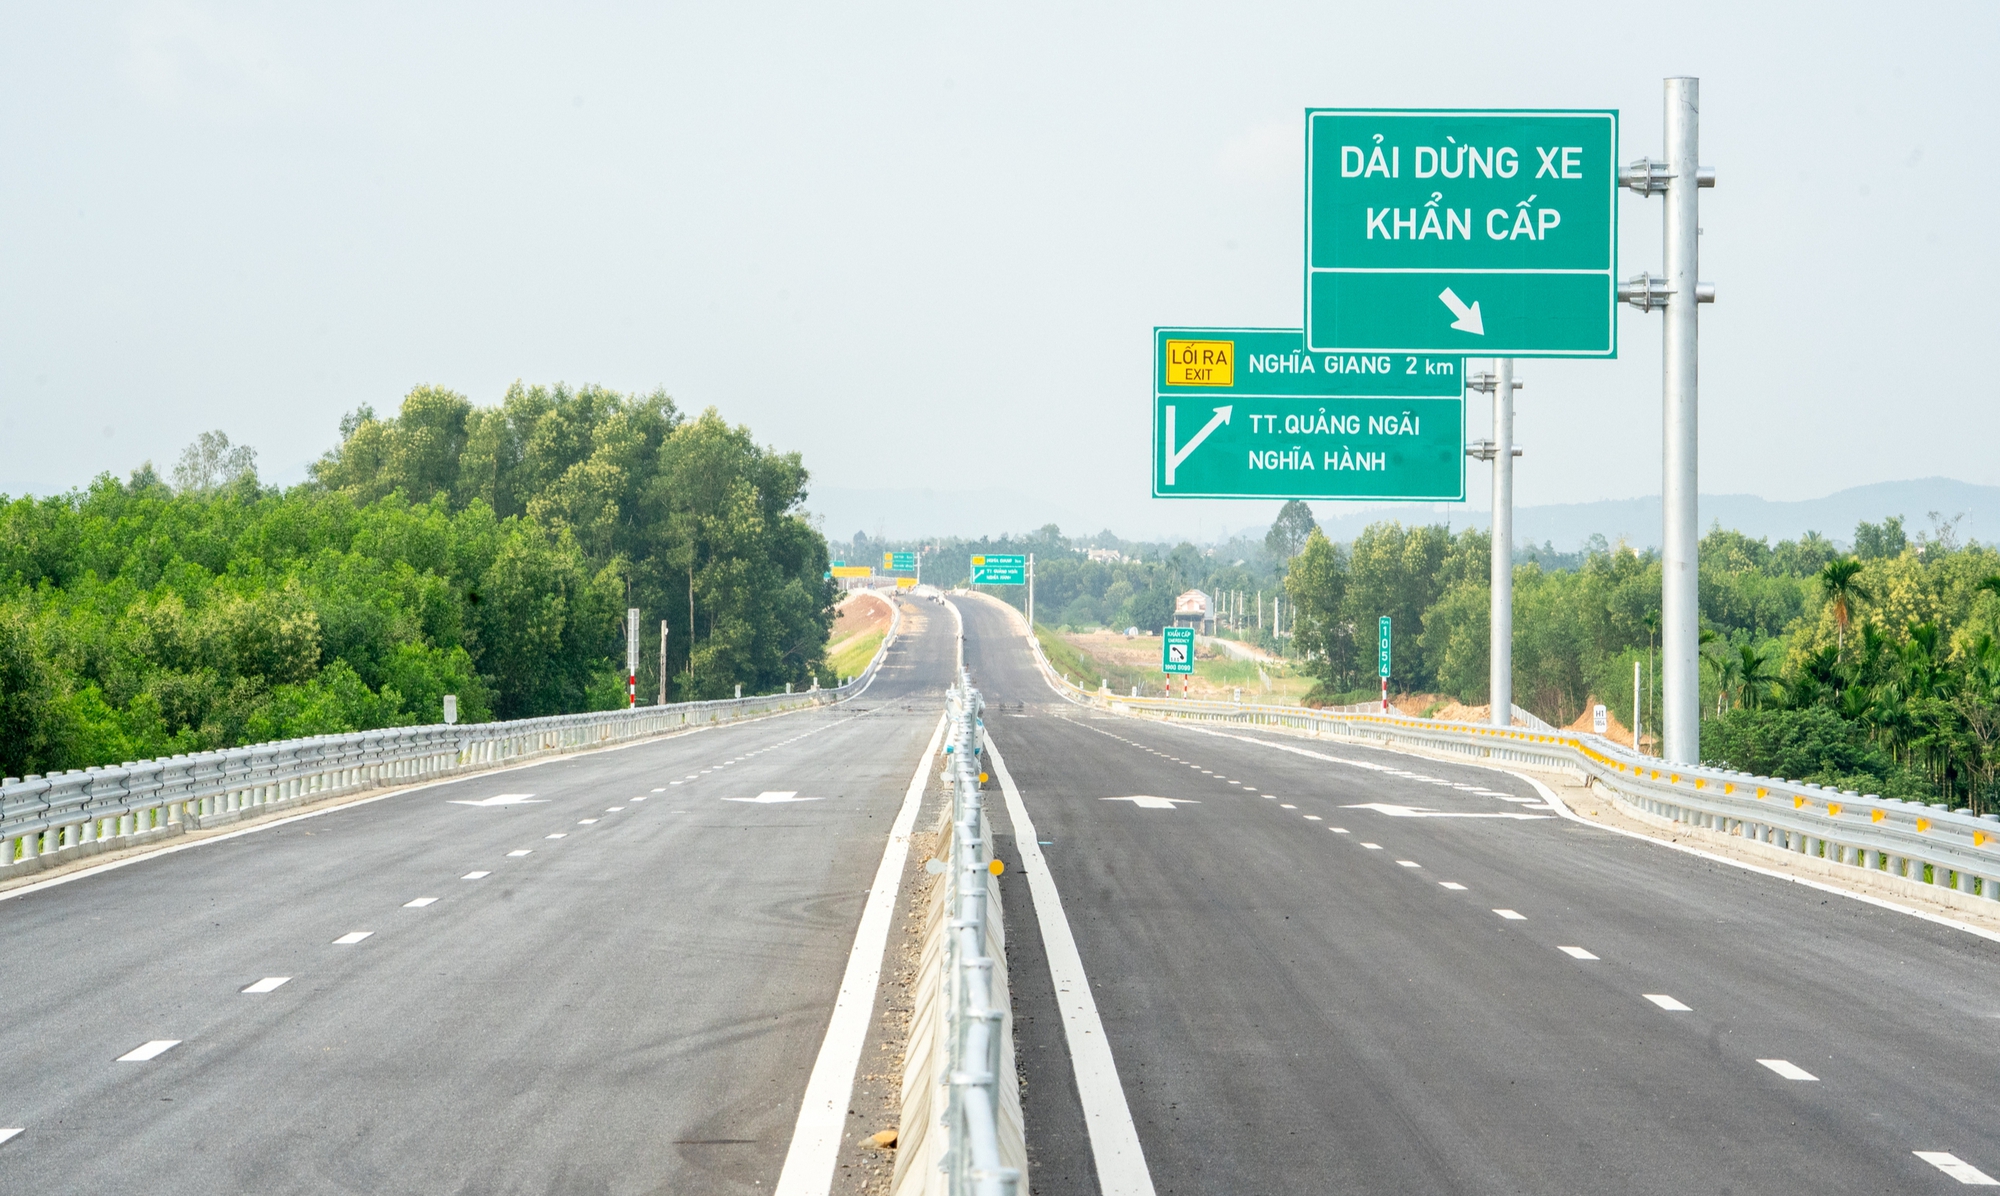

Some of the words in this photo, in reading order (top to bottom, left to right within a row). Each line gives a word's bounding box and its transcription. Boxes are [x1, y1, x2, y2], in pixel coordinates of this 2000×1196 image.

[1341, 133, 1399, 178] DẢI
[1415, 135, 1519, 179] DỪNG
[1535, 146, 1583, 179] XE
[1367, 191, 1471, 240] KHẨN
[1486, 194, 1561, 240] CẤP
[1172, 343, 1198, 365] LỐI
[1203, 349, 1228, 366] RA
[1249, 349, 1315, 374] NGHĨA
[1324, 355, 1391, 374] GIANG
[1406, 356, 1418, 375] 2
[1425, 358, 1454, 375] km
[1185, 368, 1213, 381] EXIT
[1369, 410, 1420, 435] NGÃI
[1249, 445, 1315, 470] NGHĨA
[1324, 445, 1386, 471] HÀNH
